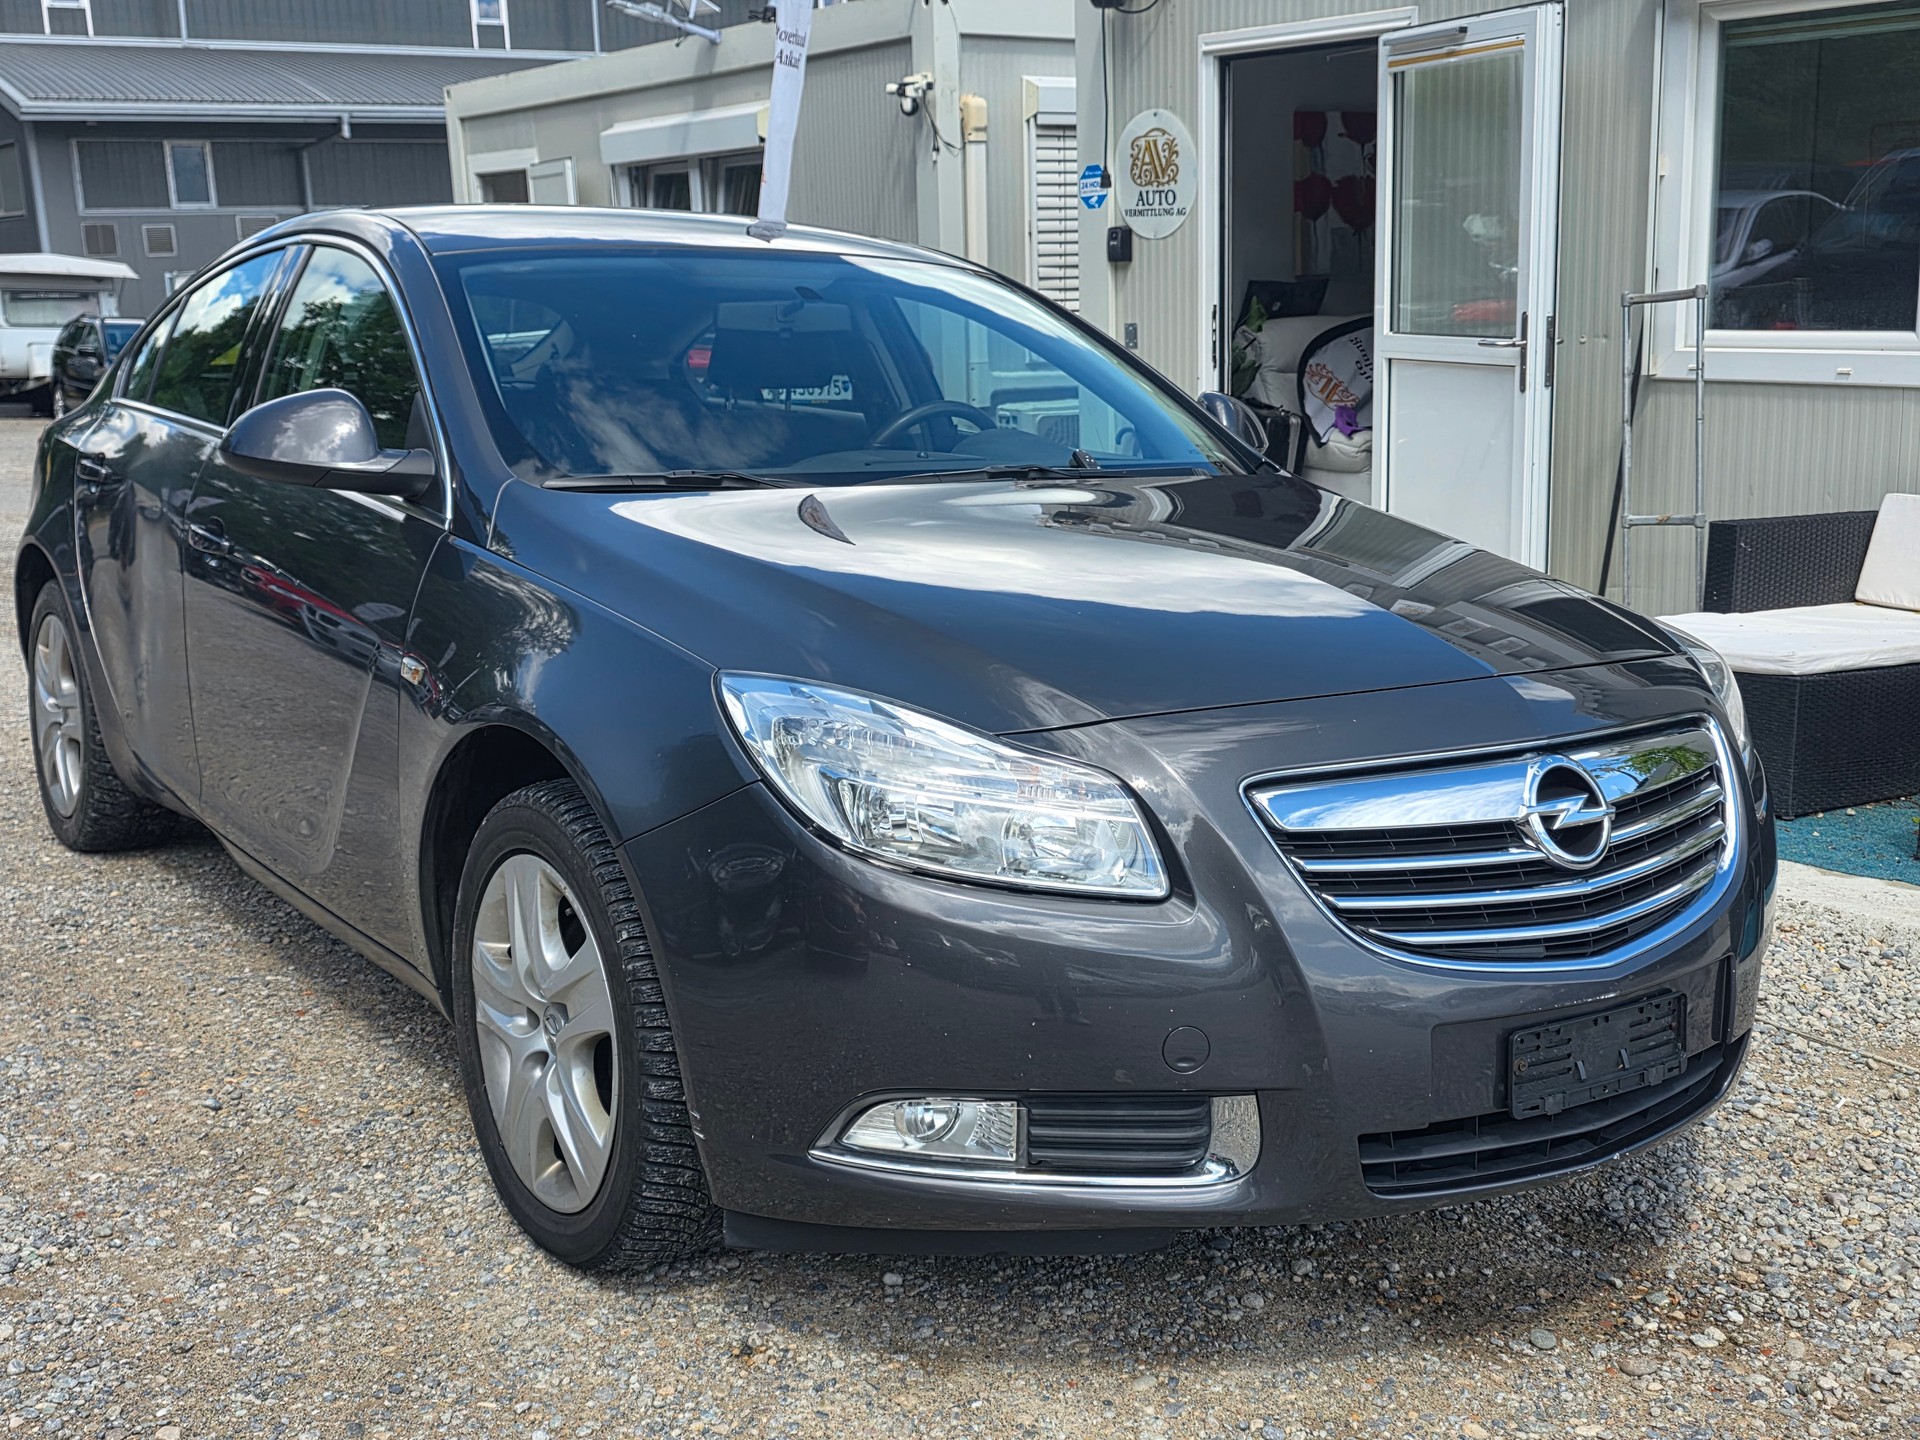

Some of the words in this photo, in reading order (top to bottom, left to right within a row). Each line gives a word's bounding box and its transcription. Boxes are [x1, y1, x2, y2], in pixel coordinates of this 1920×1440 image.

[1136, 189, 1176, 207] AUTO
[1124, 207, 1174, 218] VERMITTLUNG
[1175, 207, 1187, 217] AG
